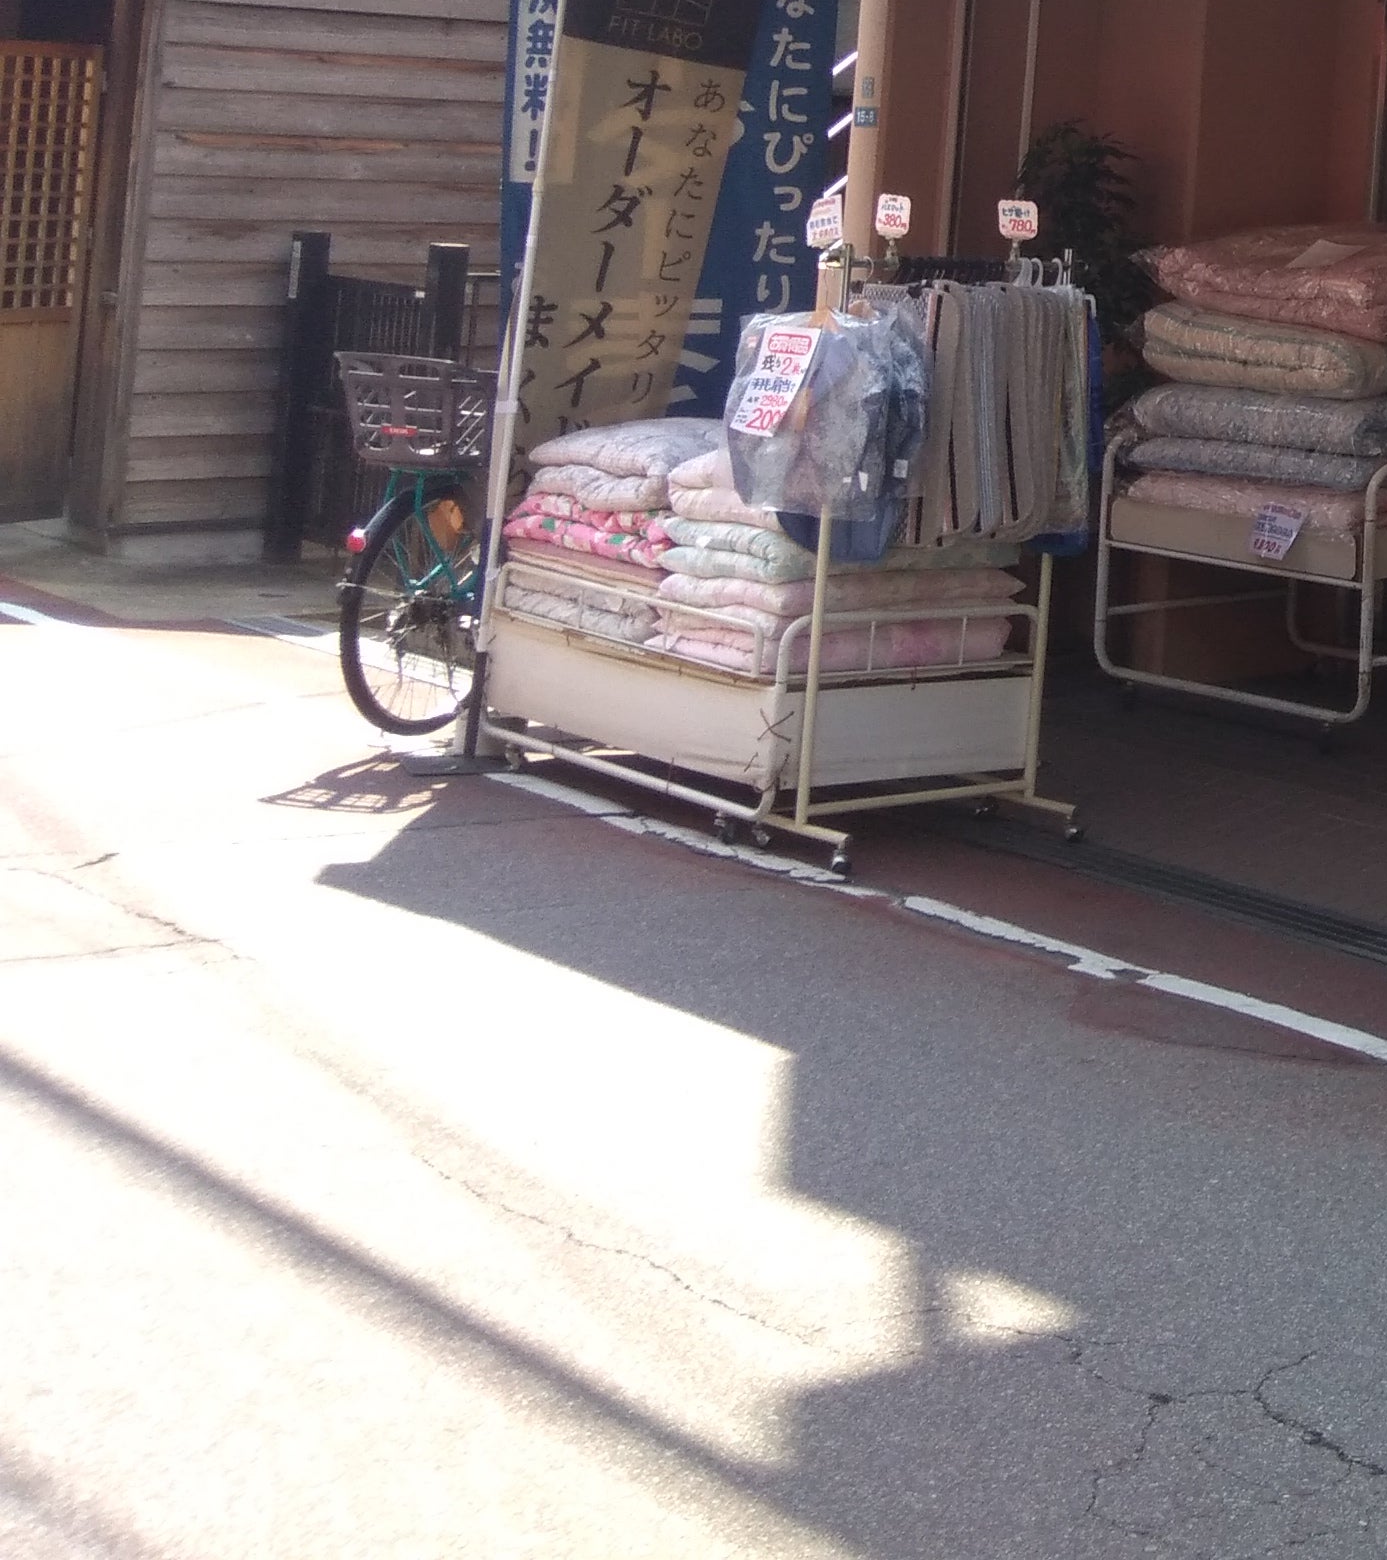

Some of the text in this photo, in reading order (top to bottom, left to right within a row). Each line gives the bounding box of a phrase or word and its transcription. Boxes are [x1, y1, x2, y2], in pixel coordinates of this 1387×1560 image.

[631, 79, 726, 404] あなたにピッタリ
